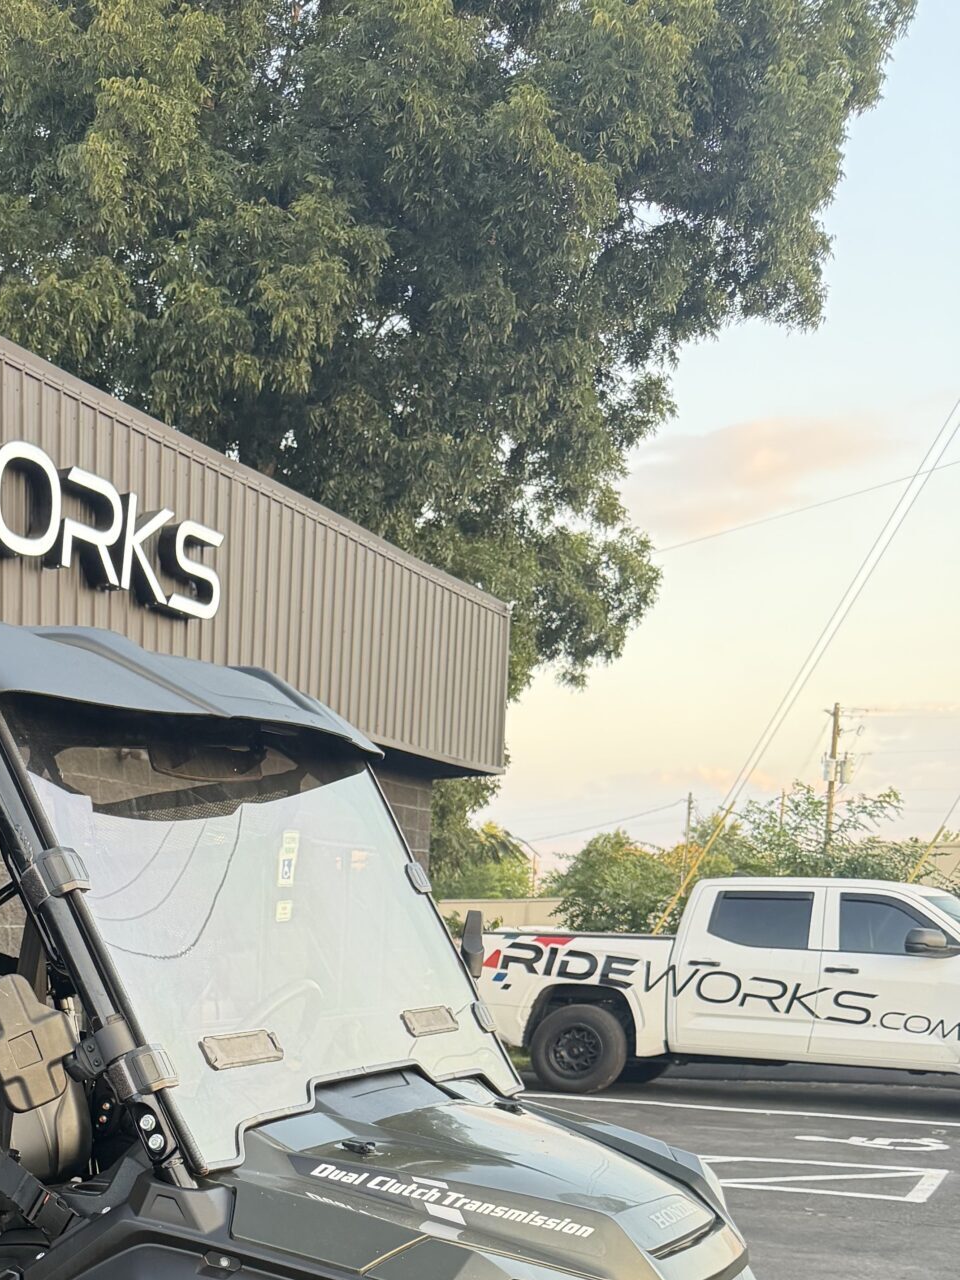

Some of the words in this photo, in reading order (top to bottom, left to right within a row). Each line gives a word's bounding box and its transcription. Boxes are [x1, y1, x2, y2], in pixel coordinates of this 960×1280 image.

[499, 941, 960, 1041] RIDEWORKS.COM
[310, 1163, 370, 1185] Dual
[367, 1175, 441, 1202] Clutch
[442, 1191, 596, 1238] Transmission
